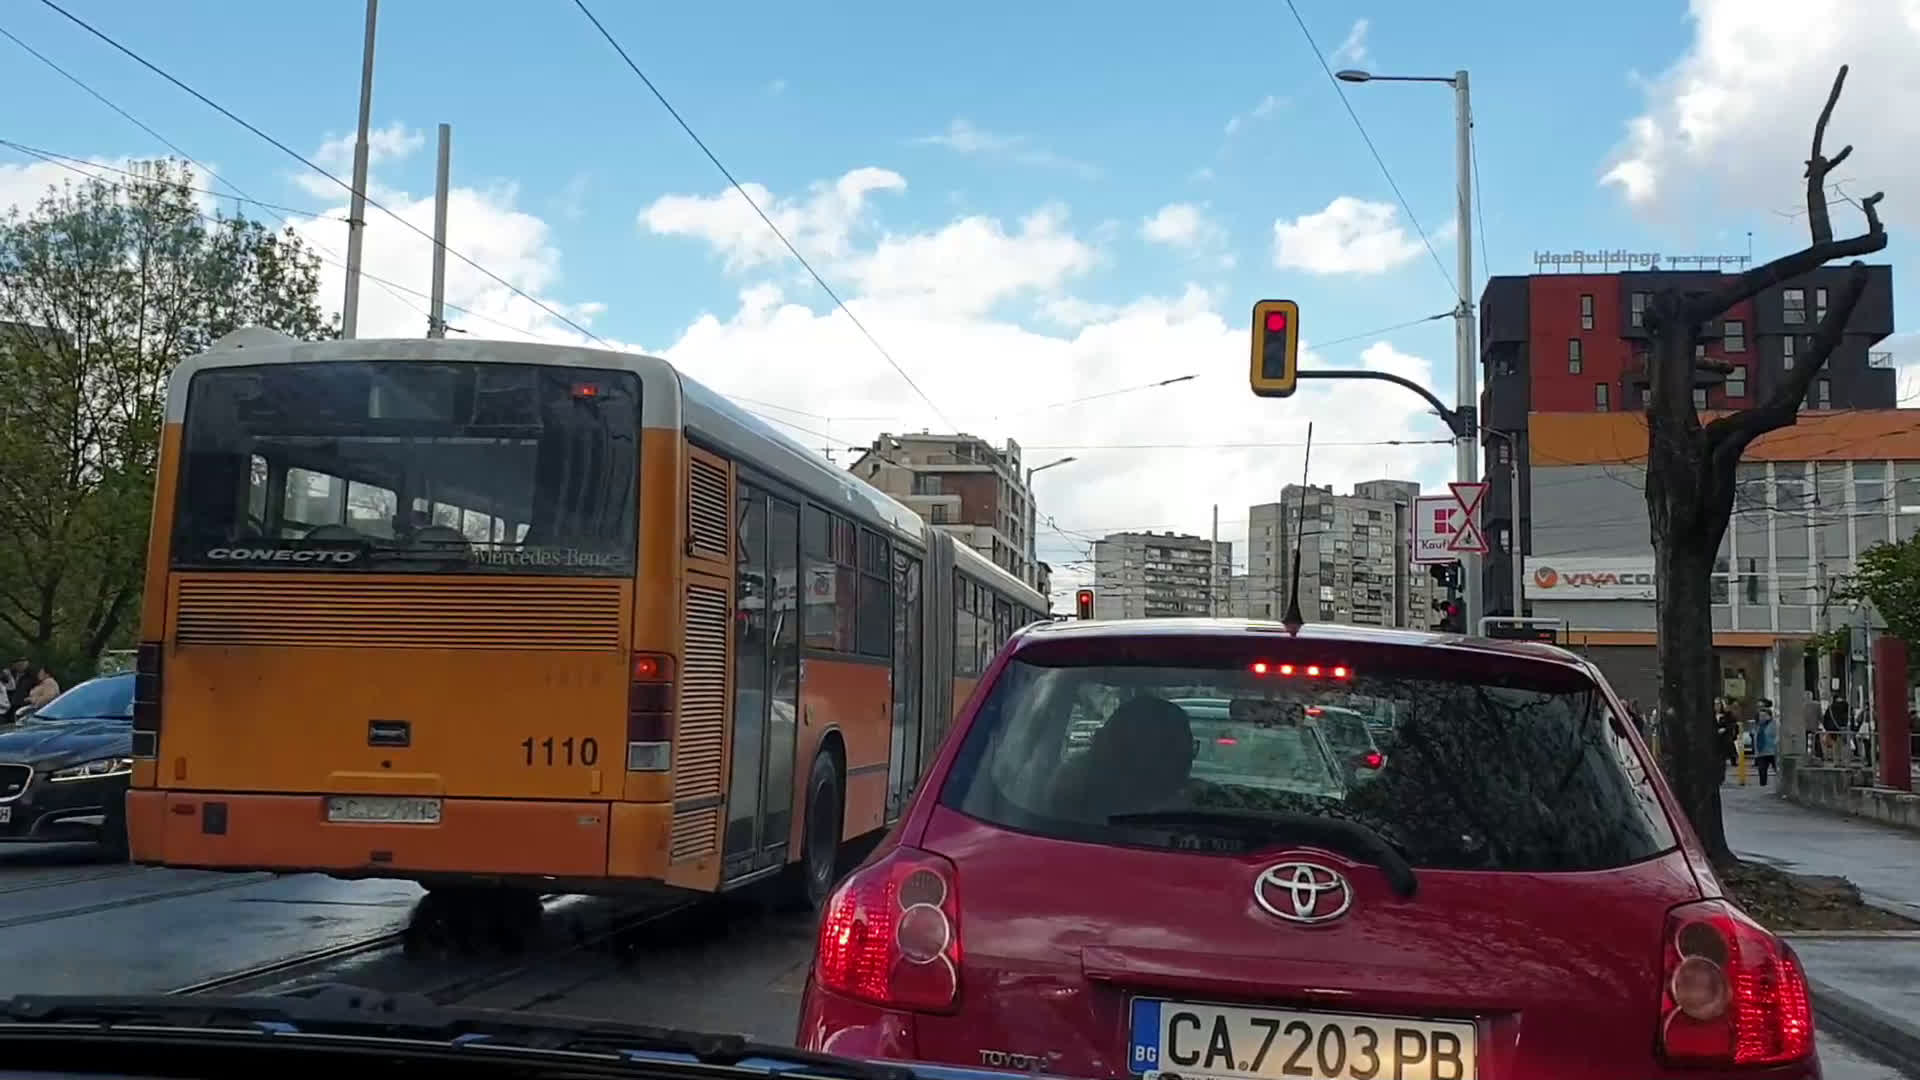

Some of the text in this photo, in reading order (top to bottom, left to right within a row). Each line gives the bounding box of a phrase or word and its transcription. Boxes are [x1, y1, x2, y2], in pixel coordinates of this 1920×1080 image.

[207, 548, 357, 563] CONECTO
[1562, 573, 1656, 585] VIVACO
[521, 736, 599, 767] 1110
[1135, 1045, 1157, 1062] BG
